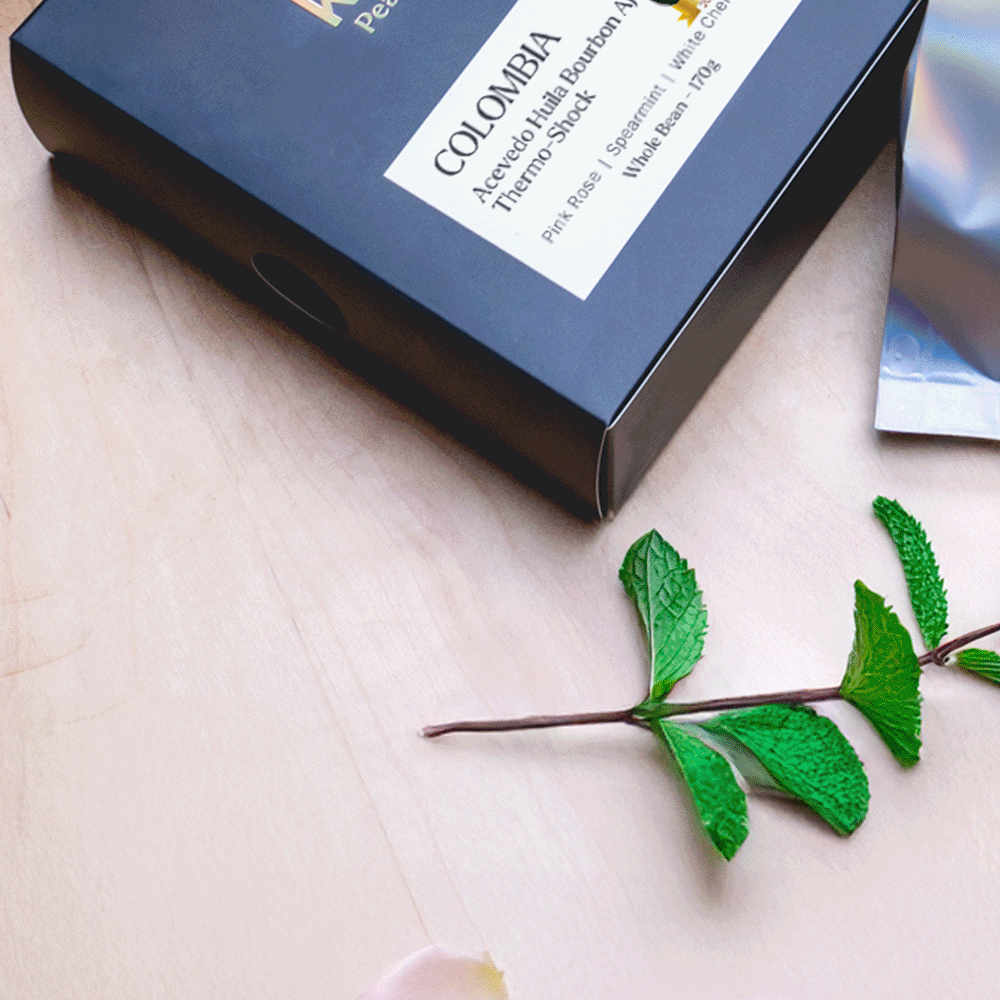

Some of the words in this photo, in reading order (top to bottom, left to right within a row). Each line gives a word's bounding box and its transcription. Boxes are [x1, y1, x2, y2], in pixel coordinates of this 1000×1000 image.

[433, 29, 562, 177] COLOMBIA
[472, 128, 535, 204] Acevedo
[526, 85, 568, 130] Huila
[559, 14, 622, 85] Bourbon
[491, 88, 596, 214] Thermo-Shock
[541, 210, 573, 244] Pink
[567, 170, 602, 210] Rose
[605, 83, 667, 157] Spearmint
[668, 29, 707, 71] White
[622, 135, 662, 180] Whole
[656, 100, 689, 138] Bean
[688, 58, 722, 91] 170g
